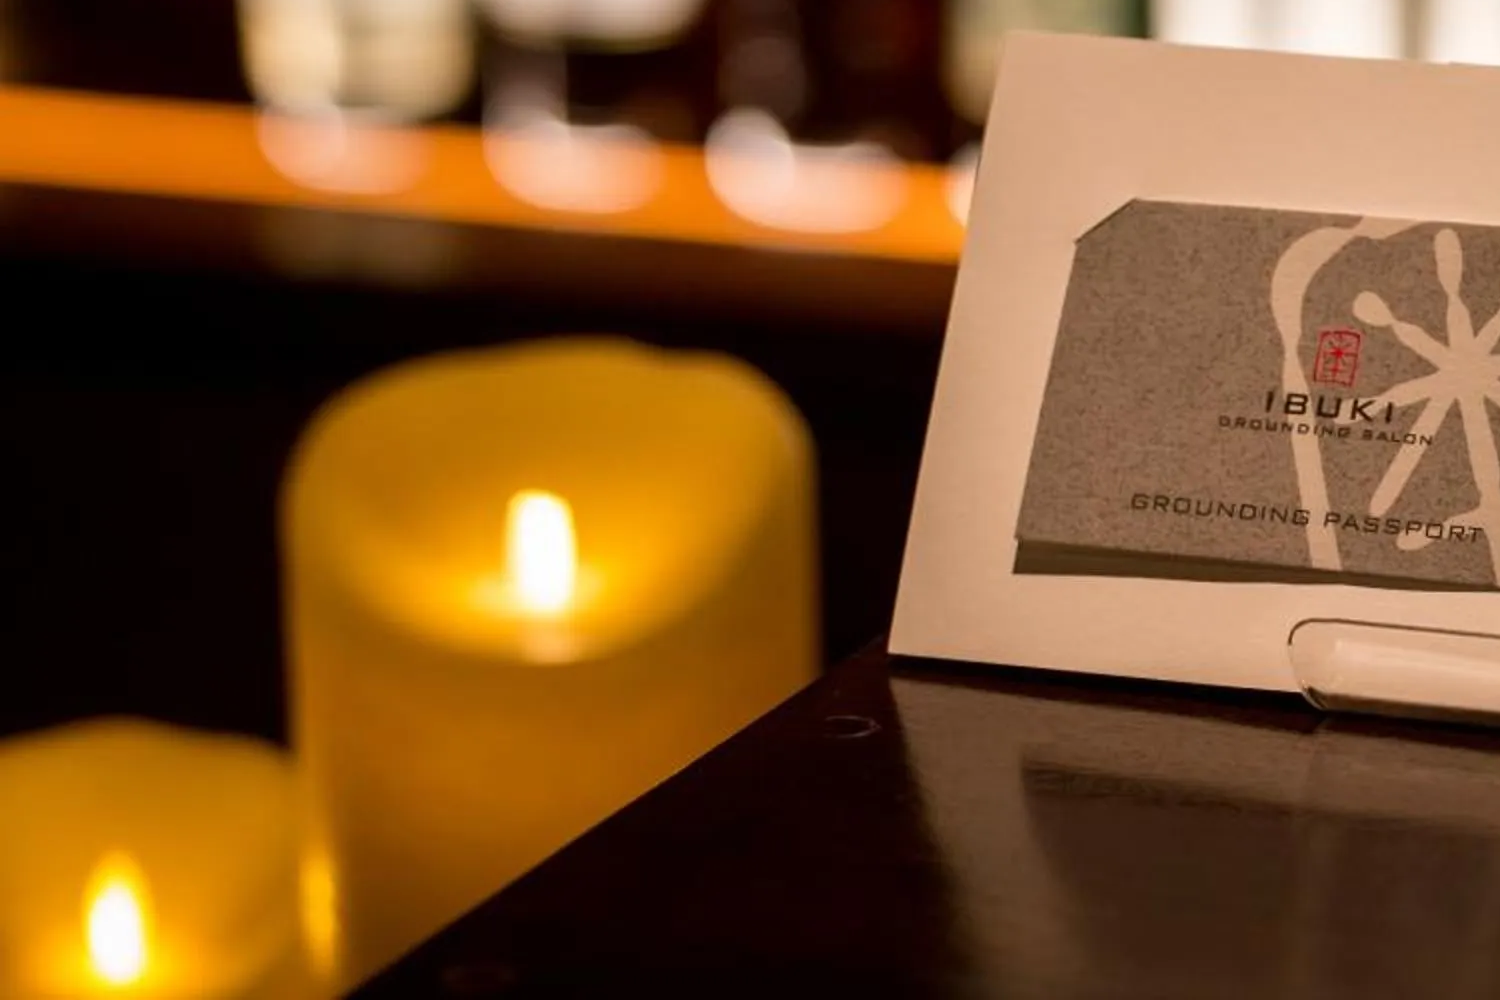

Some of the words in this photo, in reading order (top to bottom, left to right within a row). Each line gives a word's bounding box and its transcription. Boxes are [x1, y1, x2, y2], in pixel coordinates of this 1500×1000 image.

[1265, 390, 1394, 425] IBUKI
[1218, 415, 1351, 439] GROUNDING
[1362, 430, 1433, 447] SALON
[1130, 493, 1310, 526] GROUNDING
[1323, 512, 1484, 543] PASSPORT
